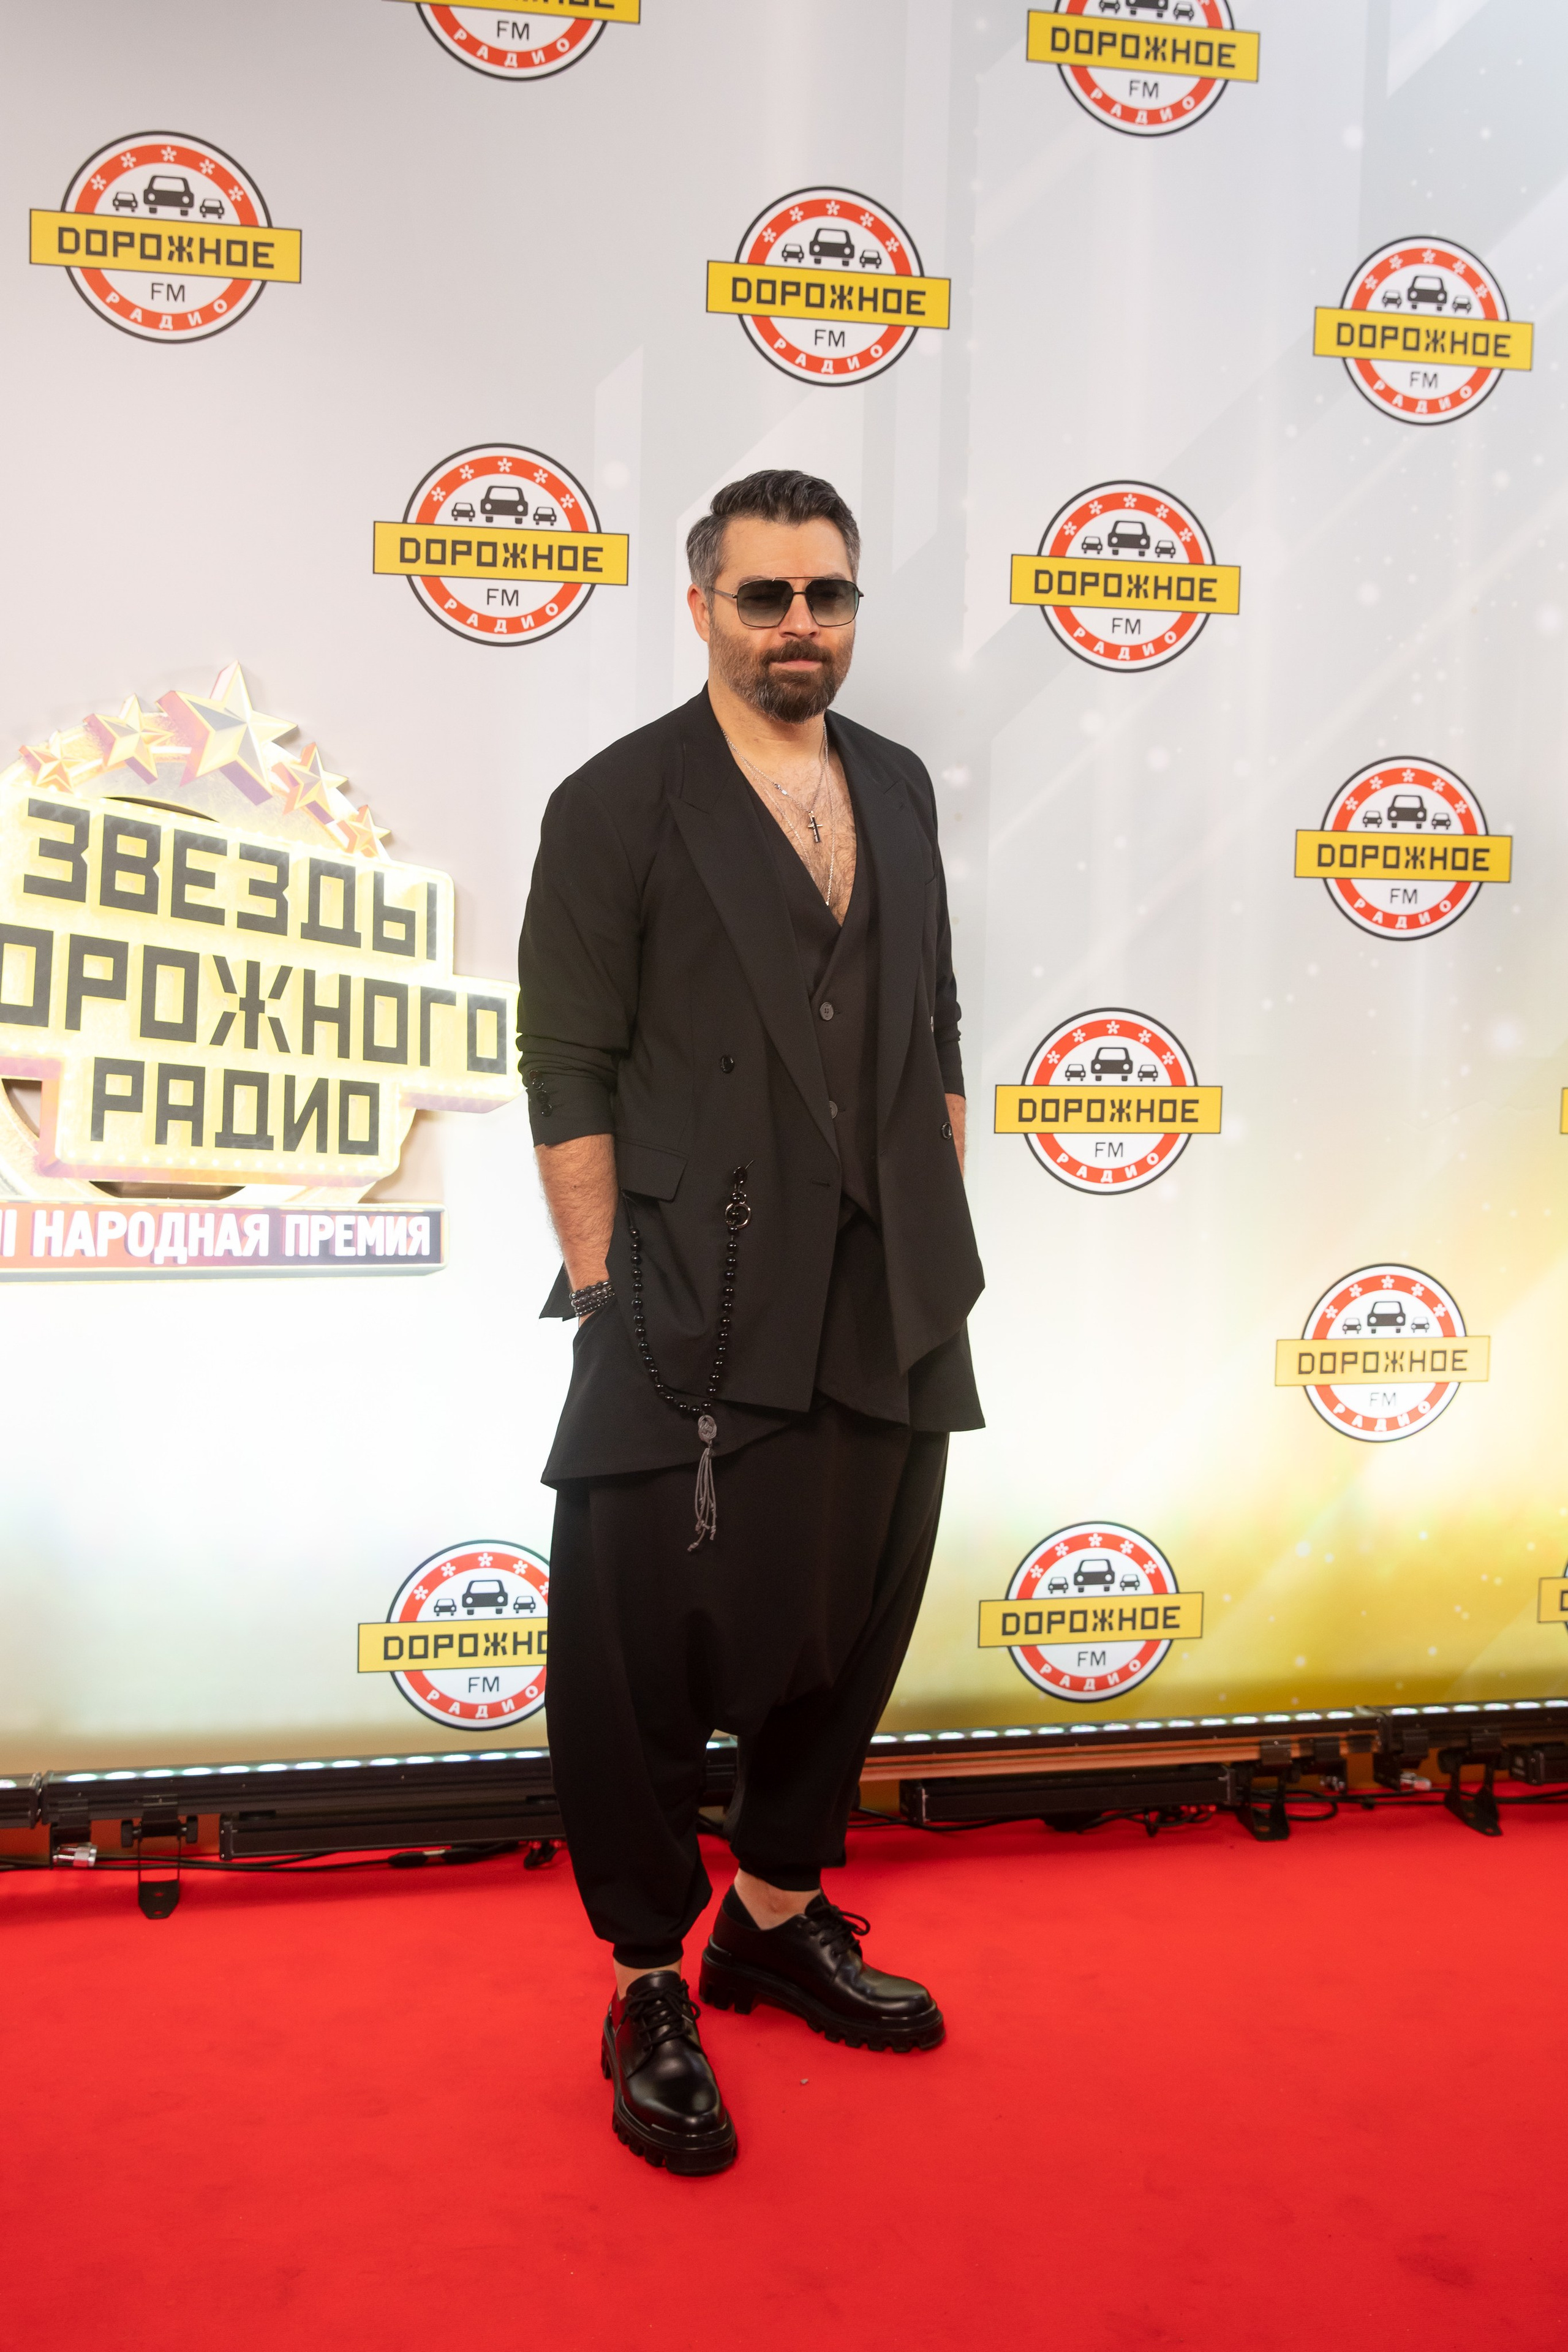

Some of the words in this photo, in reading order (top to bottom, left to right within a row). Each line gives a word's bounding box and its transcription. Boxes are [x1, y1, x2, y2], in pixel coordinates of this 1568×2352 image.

[497, 20, 529, 40] FM
[454, 28, 570, 67] РАДИО
[1129, 80, 1159, 99] FM
[1090, 88, 1195, 124] РАДИО
[151, 282, 185, 302] FM
[106, 292, 227, 330] РАДИО
[814, 329, 845, 347] FM
[774, 337, 883, 374] РАДИО
[1409, 371, 1438, 388] FM
[1373, 379, 1472, 413] РАДИО
[486, 588, 519, 606] FM
[444, 598, 559, 633] РАДИО
[1112, 617, 1141, 635] FM
[1073, 627, 1177, 660] РАДИО
[23, 798, 438, 961] ЗВЕЗДЫ
[1390, 888, 1417, 904] FM
[1354, 898, 1452, 929] РАДИО
[90, 1057, 380, 1156] РАДИО
[1095, 1142, 1123, 1157] FM
[1057, 1153, 1159, 1183] РАДИО
[32, 1210, 270, 1264] НАРОДНАЯ
[284, 1214, 431, 1257] ПРЕМИЯ
[1370, 1392, 1396, 1406] FM
[1333, 1400, 1431, 1431] РАДИО
[1077, 1651, 1106, 1667] FM
[467, 1676, 500, 1693] FM
[1039, 1659, 1141, 1691] РАДИО
[426, 1684, 538, 1719] РАДИО
